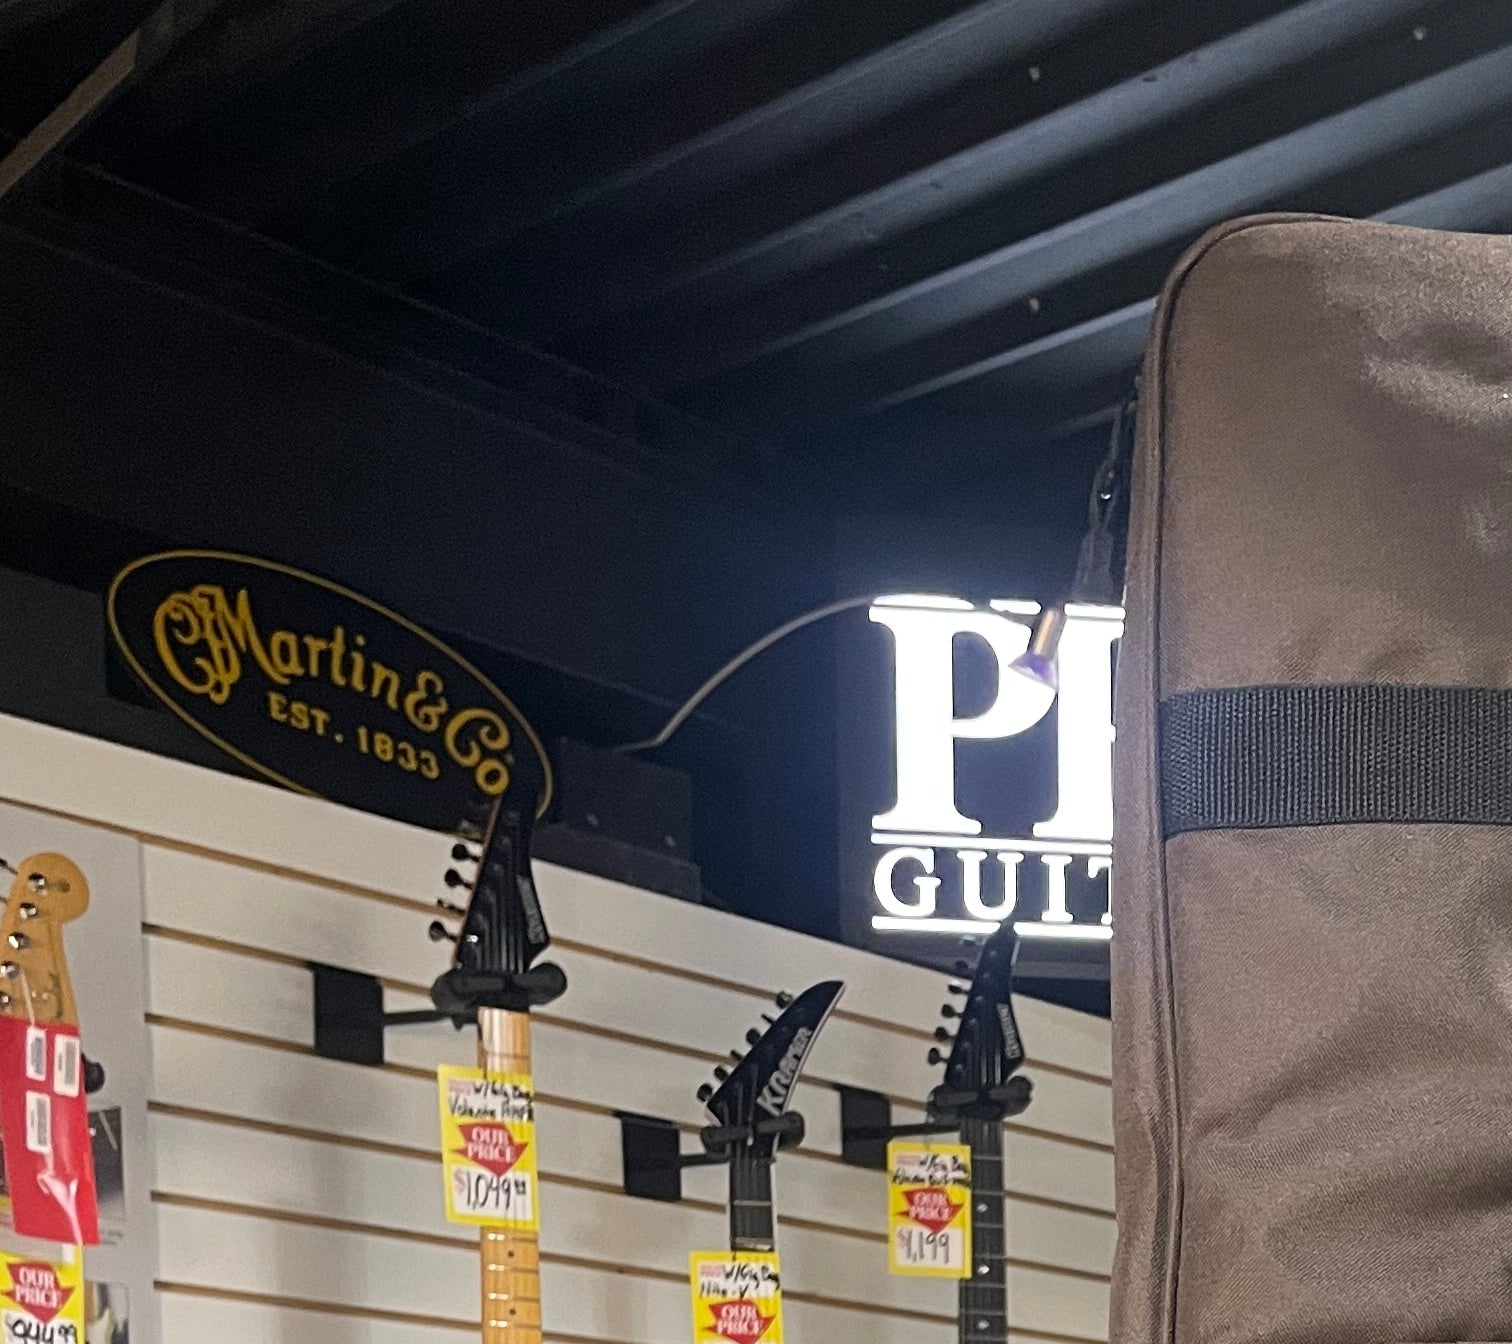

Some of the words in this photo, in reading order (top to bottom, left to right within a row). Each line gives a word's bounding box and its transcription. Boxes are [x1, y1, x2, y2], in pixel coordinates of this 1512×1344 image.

[268, 690, 344, 744] EST.
[356, 726, 440, 780] 1833
[472, 1127, 509, 1146] OUR
[19, 1266, 56, 1289] OUR
